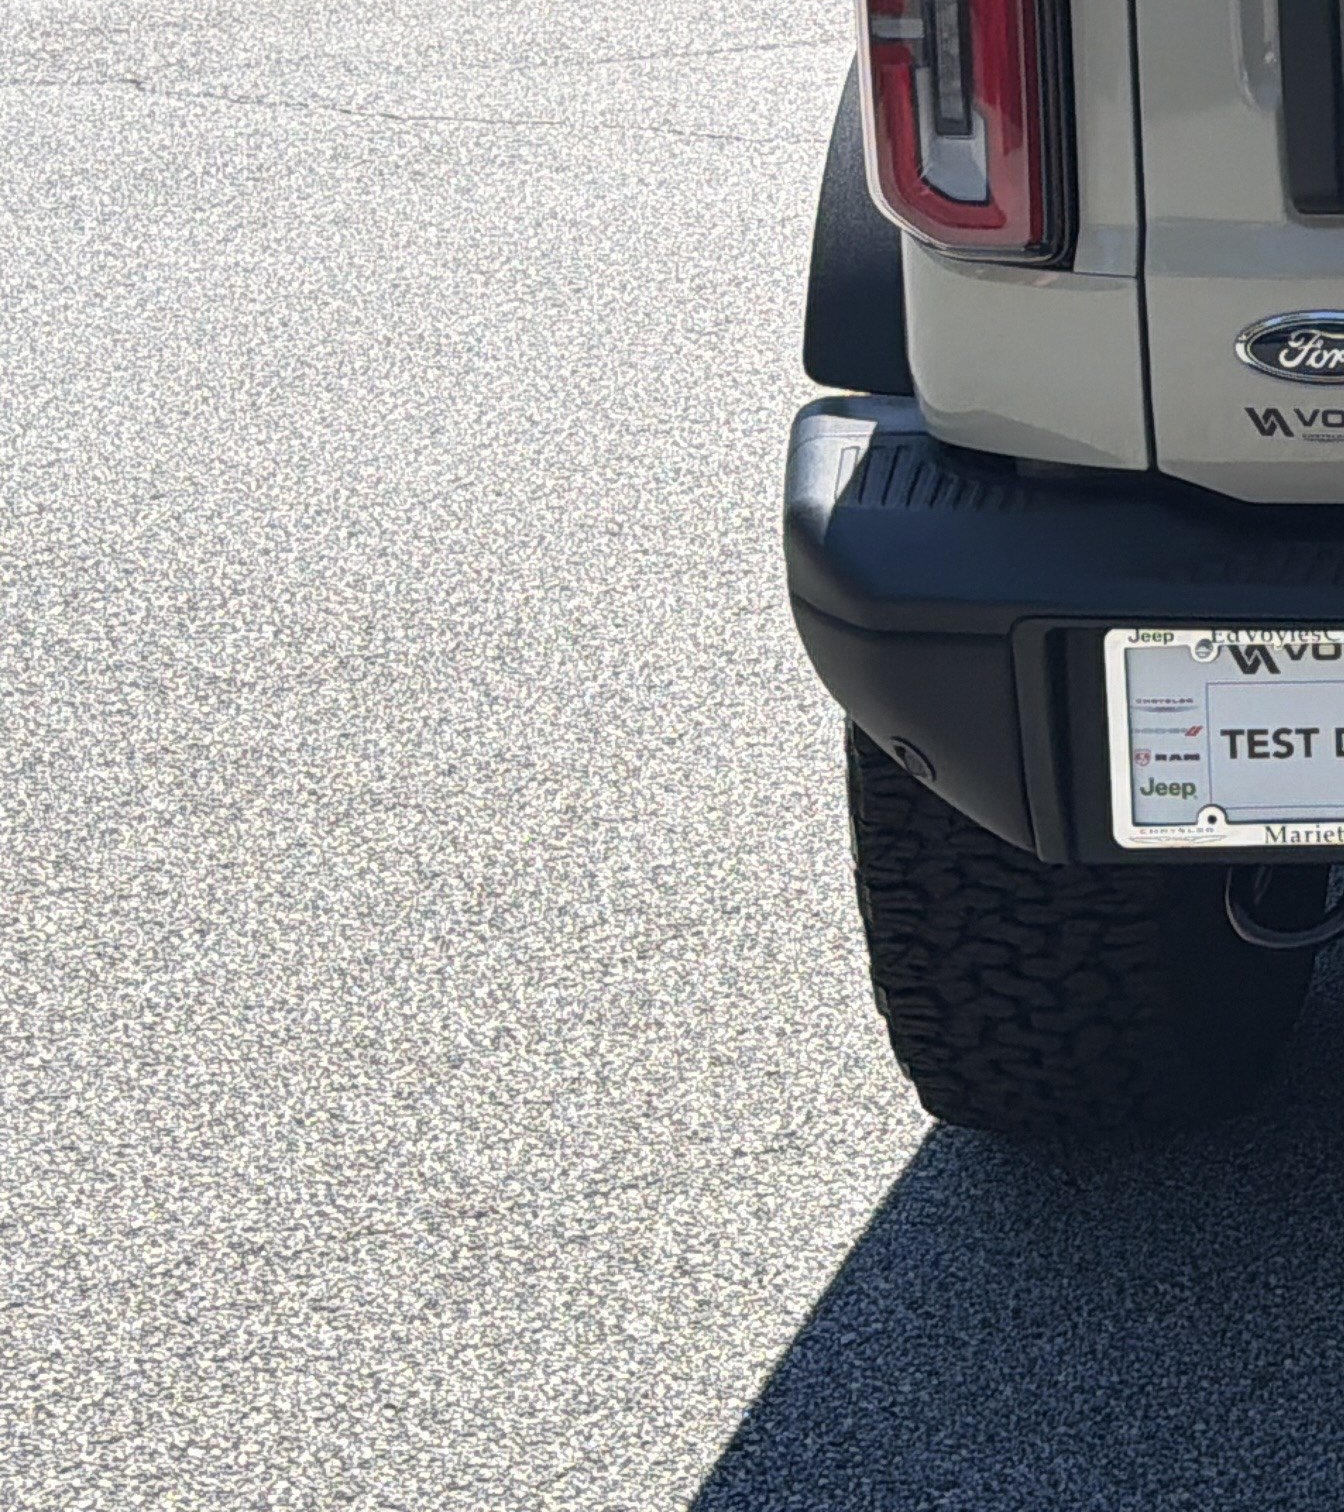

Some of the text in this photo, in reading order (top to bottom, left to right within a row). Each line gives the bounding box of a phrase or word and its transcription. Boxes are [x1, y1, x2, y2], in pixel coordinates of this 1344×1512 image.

[1128, 629, 1174, 645] Jeep
[1220, 727, 1320, 760] TEST
[1154, 752, 1200, 762] RAM
[1140, 777, 1197, 800] Jeep
